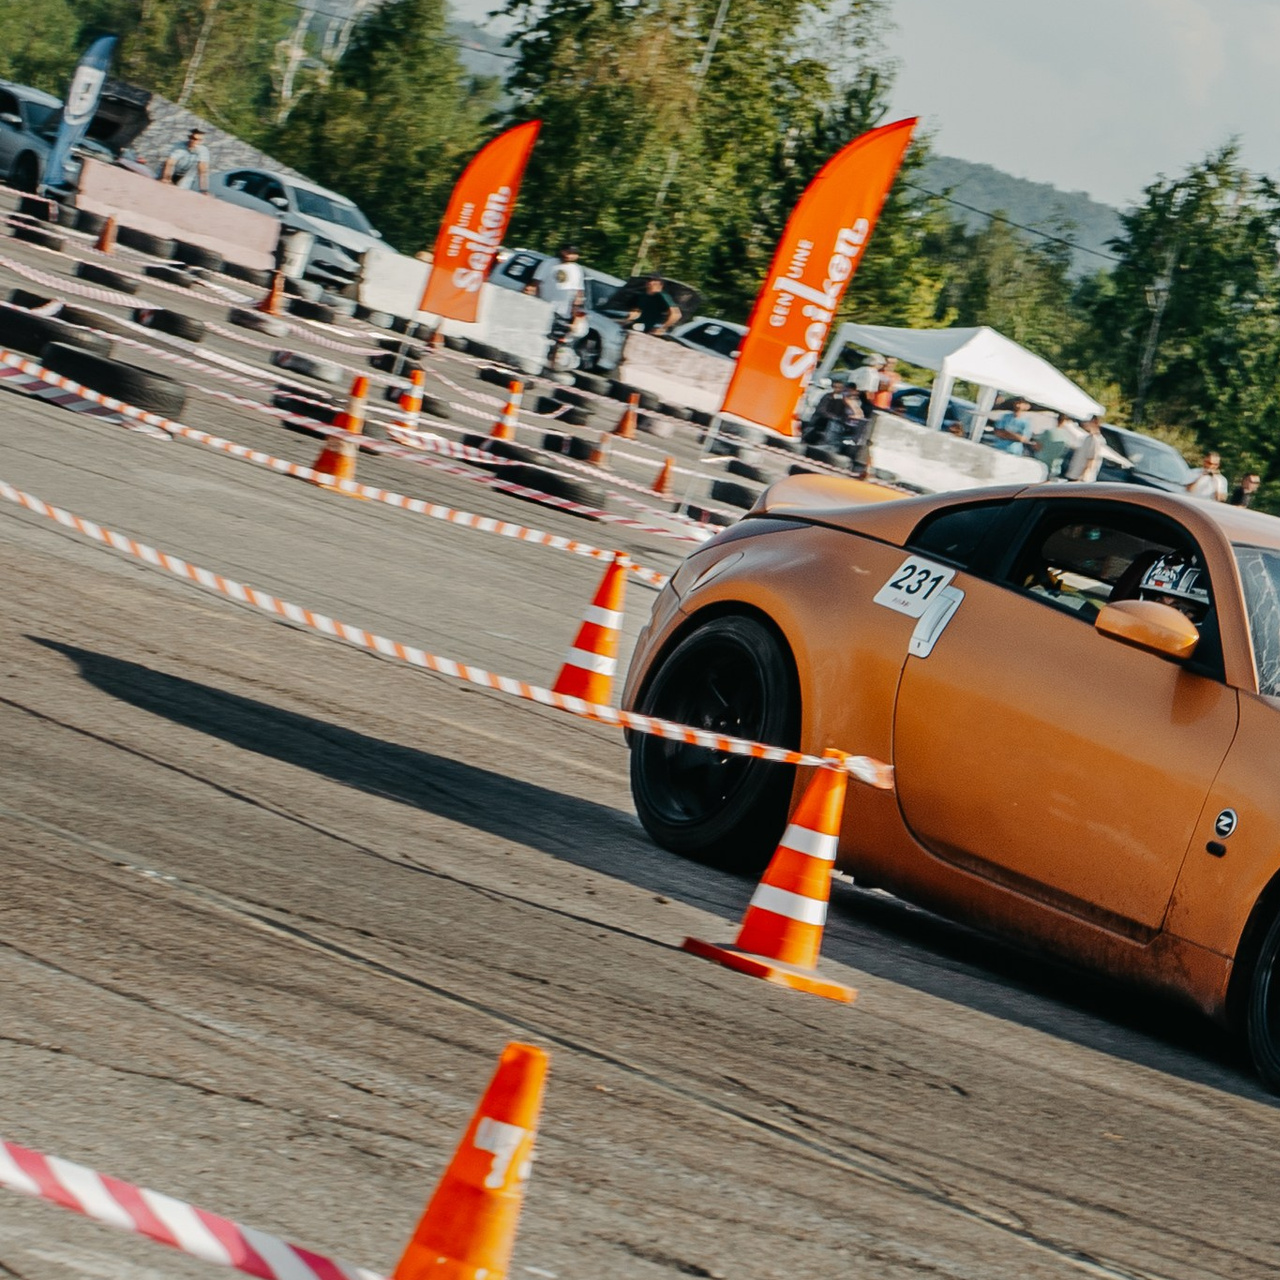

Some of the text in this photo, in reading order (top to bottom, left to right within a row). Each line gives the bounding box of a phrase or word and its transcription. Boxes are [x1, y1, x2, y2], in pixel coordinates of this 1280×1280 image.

[769, 239, 814, 327] GENUINE
[773, 217, 869, 387] Seiken
[889, 564, 945, 600] 231
